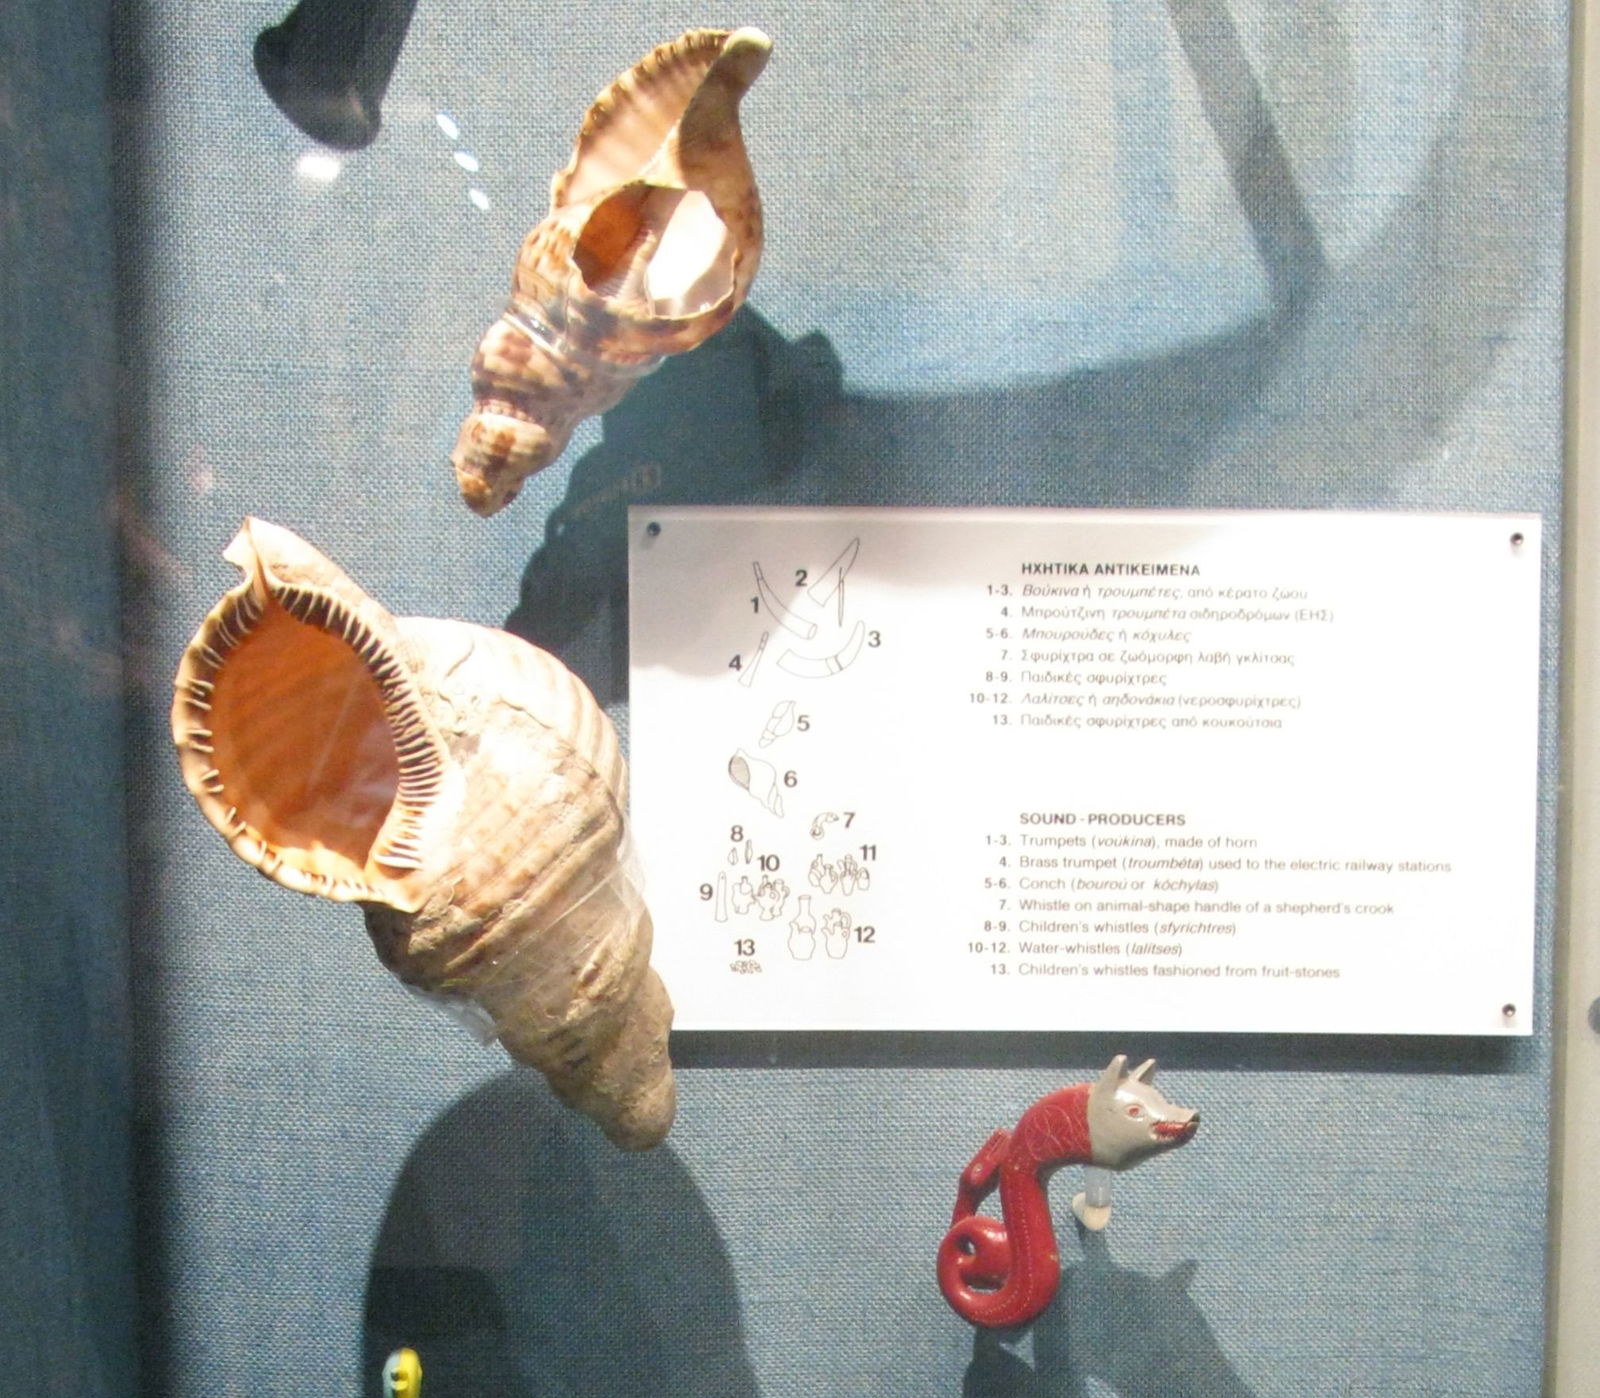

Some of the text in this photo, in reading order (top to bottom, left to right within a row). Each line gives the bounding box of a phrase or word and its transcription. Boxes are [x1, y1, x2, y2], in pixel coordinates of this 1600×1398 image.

[1021, 563, 1200, 576] ΗΧΗΤΙΚΑ ΑΝΤΙΚΕΙΜΕΝΑ
[795, 569, 808, 587] 2
[987, 585, 1012, 596] 1-3.
[751, 597, 759, 613] 1
[1000, 607, 1012, 617] 4.
[1295, 609, 1334, 623] (ΕΗΣ)
[868, 630, 881, 648] 3
[986, 628, 1012, 639] 5-6.
[728, 654, 742, 671] 4
[1001, 650, 1012, 661] 7.
[986, 671, 1012, 683] 8-9.
[970, 693, 1012, 704] 10-12.
[797, 715, 810, 732] 5
[993, 715, 1012, 726] 13.
[784, 770, 798, 788] 6
[844, 812, 856, 828] 7
[1020, 813, 1076, 825] SOUND
[1088, 813, 1186, 826] PRODUCERS
[730, 825, 744, 843] 8
[986, 835, 1011, 846] 1-3.
[1020, 834, 1087, 850] Trumpets
[1165, 835, 1203, 848] made
[1208, 836, 1221, 848] of
[1226, 837, 1257, 849] horn
[859, 844, 877, 861] 11
[757, 854, 780, 872] 10
[999, 857, 1011, 867] 4.
[1020, 856, 1058, 868] Brass
[1063, 857, 1117, 870] trumpet
[1209, 858, 1241, 870] used
[1246, 859, 1259, 870] to
[1264, 859, 1285, 870] the
[1290, 859, 1340, 871] electric
[1345, 860, 1393, 874] railway
[1399, 860, 1451, 872] stations
[984, 878, 1011, 889] 5-6.
[1019, 877, 1065, 889] Conch
[1131, 881, 1145, 890] or
[699, 883, 713, 901] 9
[999, 900, 1011, 911] 7.
[1019, 899, 1070, 911] Whistle
[1074, 902, 1092, 911] on
[1097, 900, 1190, 915] animal-shape
[1195, 901, 1241, 913] handle
[1246, 901, 1259, 913] of
[1264, 904, 1271, 913] a
[1355, 903, 1394, 914] crook
[854, 926, 875, 943] 12
[984, 921, 1010, 932] 8-9.
[1094, 921, 1149, 934] whistles
[734, 939, 755, 957] 13
[968, 942, 1010, 954] 10-12.
[1019, 942, 1121, 954] Water-whistles
[991, 964, 1010, 975] 13.
[1093, 964, 1148, 976] whistles
[1153, 965, 1220, 977] fashioned
[1225, 965, 1257, 977] from
[1262, 966, 1340, 978] fruit-stones
